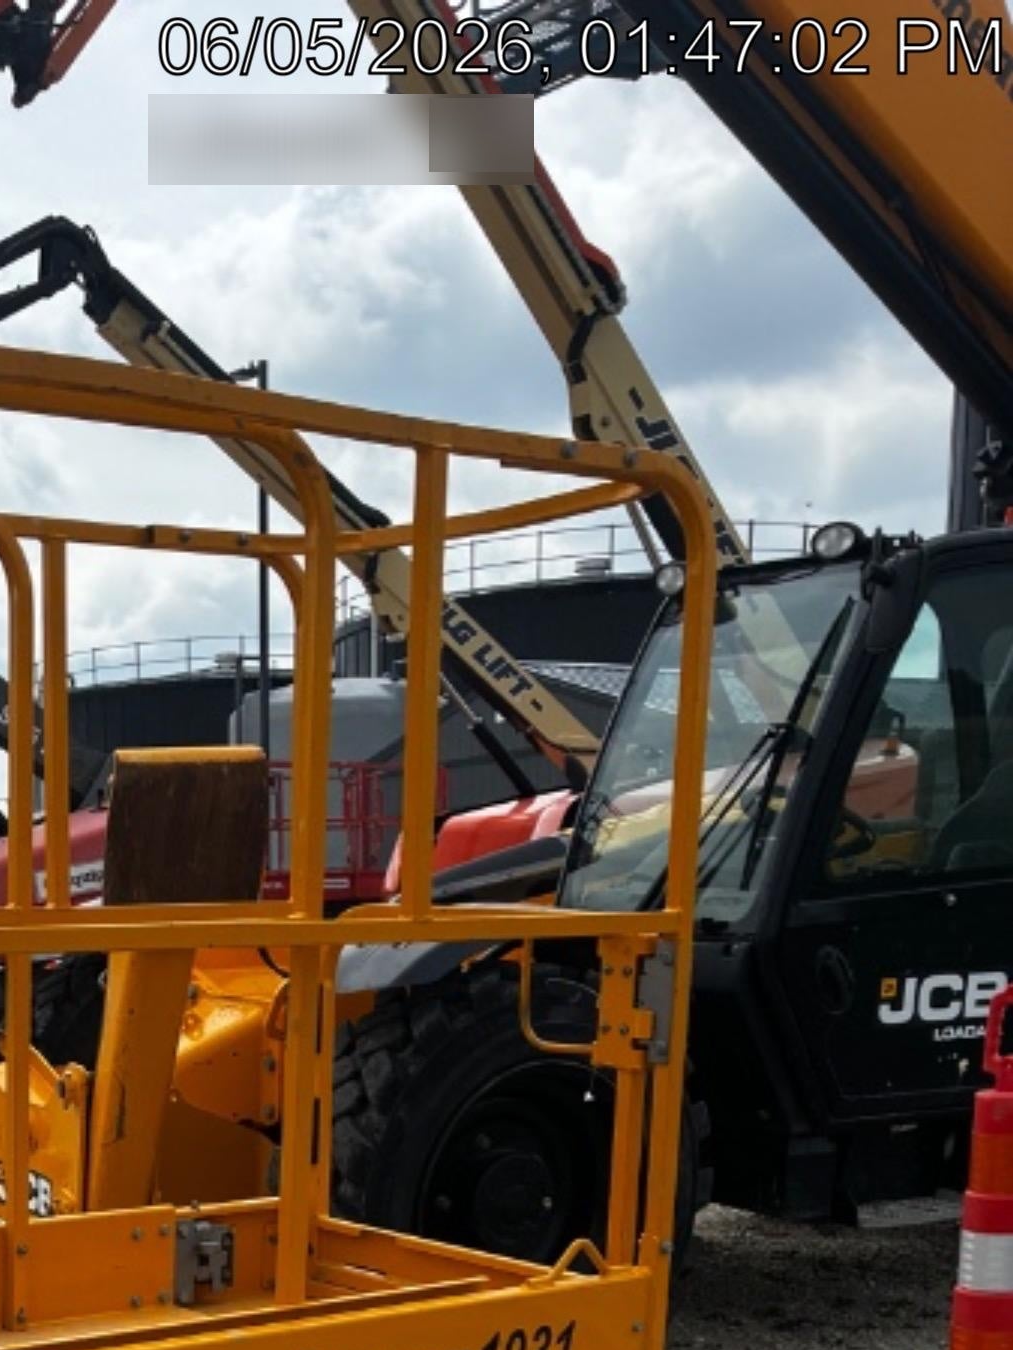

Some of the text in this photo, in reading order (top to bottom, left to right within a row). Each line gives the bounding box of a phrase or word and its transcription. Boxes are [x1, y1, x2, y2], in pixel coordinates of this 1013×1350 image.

[443, 601, 533, 696] LG LIFT
[878, 972, 1009, 1024] JCB
